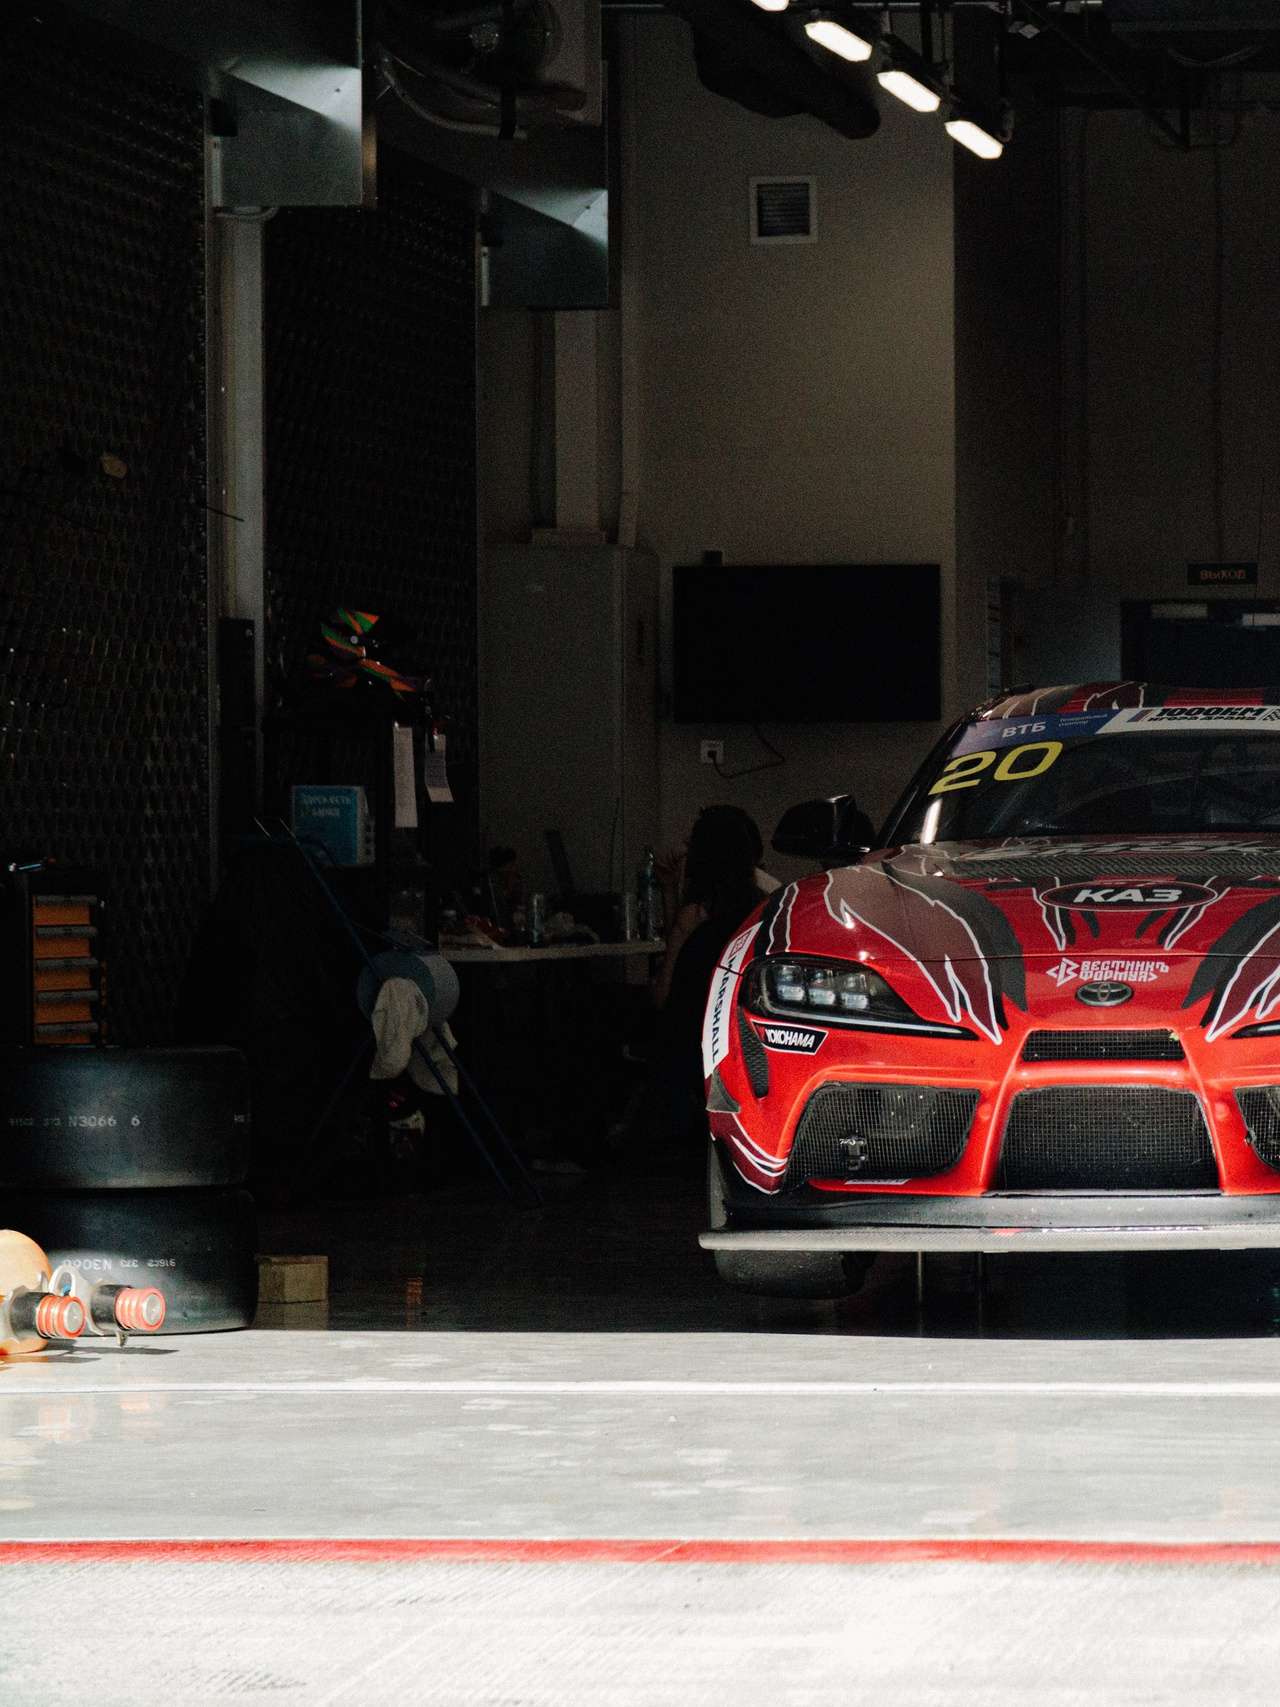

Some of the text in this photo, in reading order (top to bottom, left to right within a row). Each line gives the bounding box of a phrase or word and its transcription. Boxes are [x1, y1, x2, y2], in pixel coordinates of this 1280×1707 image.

[1200, 569, 1246, 580] ВЫХОД
[1002, 722, 1046, 738] ВТБ
[928, 741, 1064, 796] 20
[712, 956, 737, 1064] MARSHALL
[765, 1028, 816, 1048] YOKOHAMA
[68, 1115, 117, 1127] N3066
[131, 1115, 141, 1127] 6
